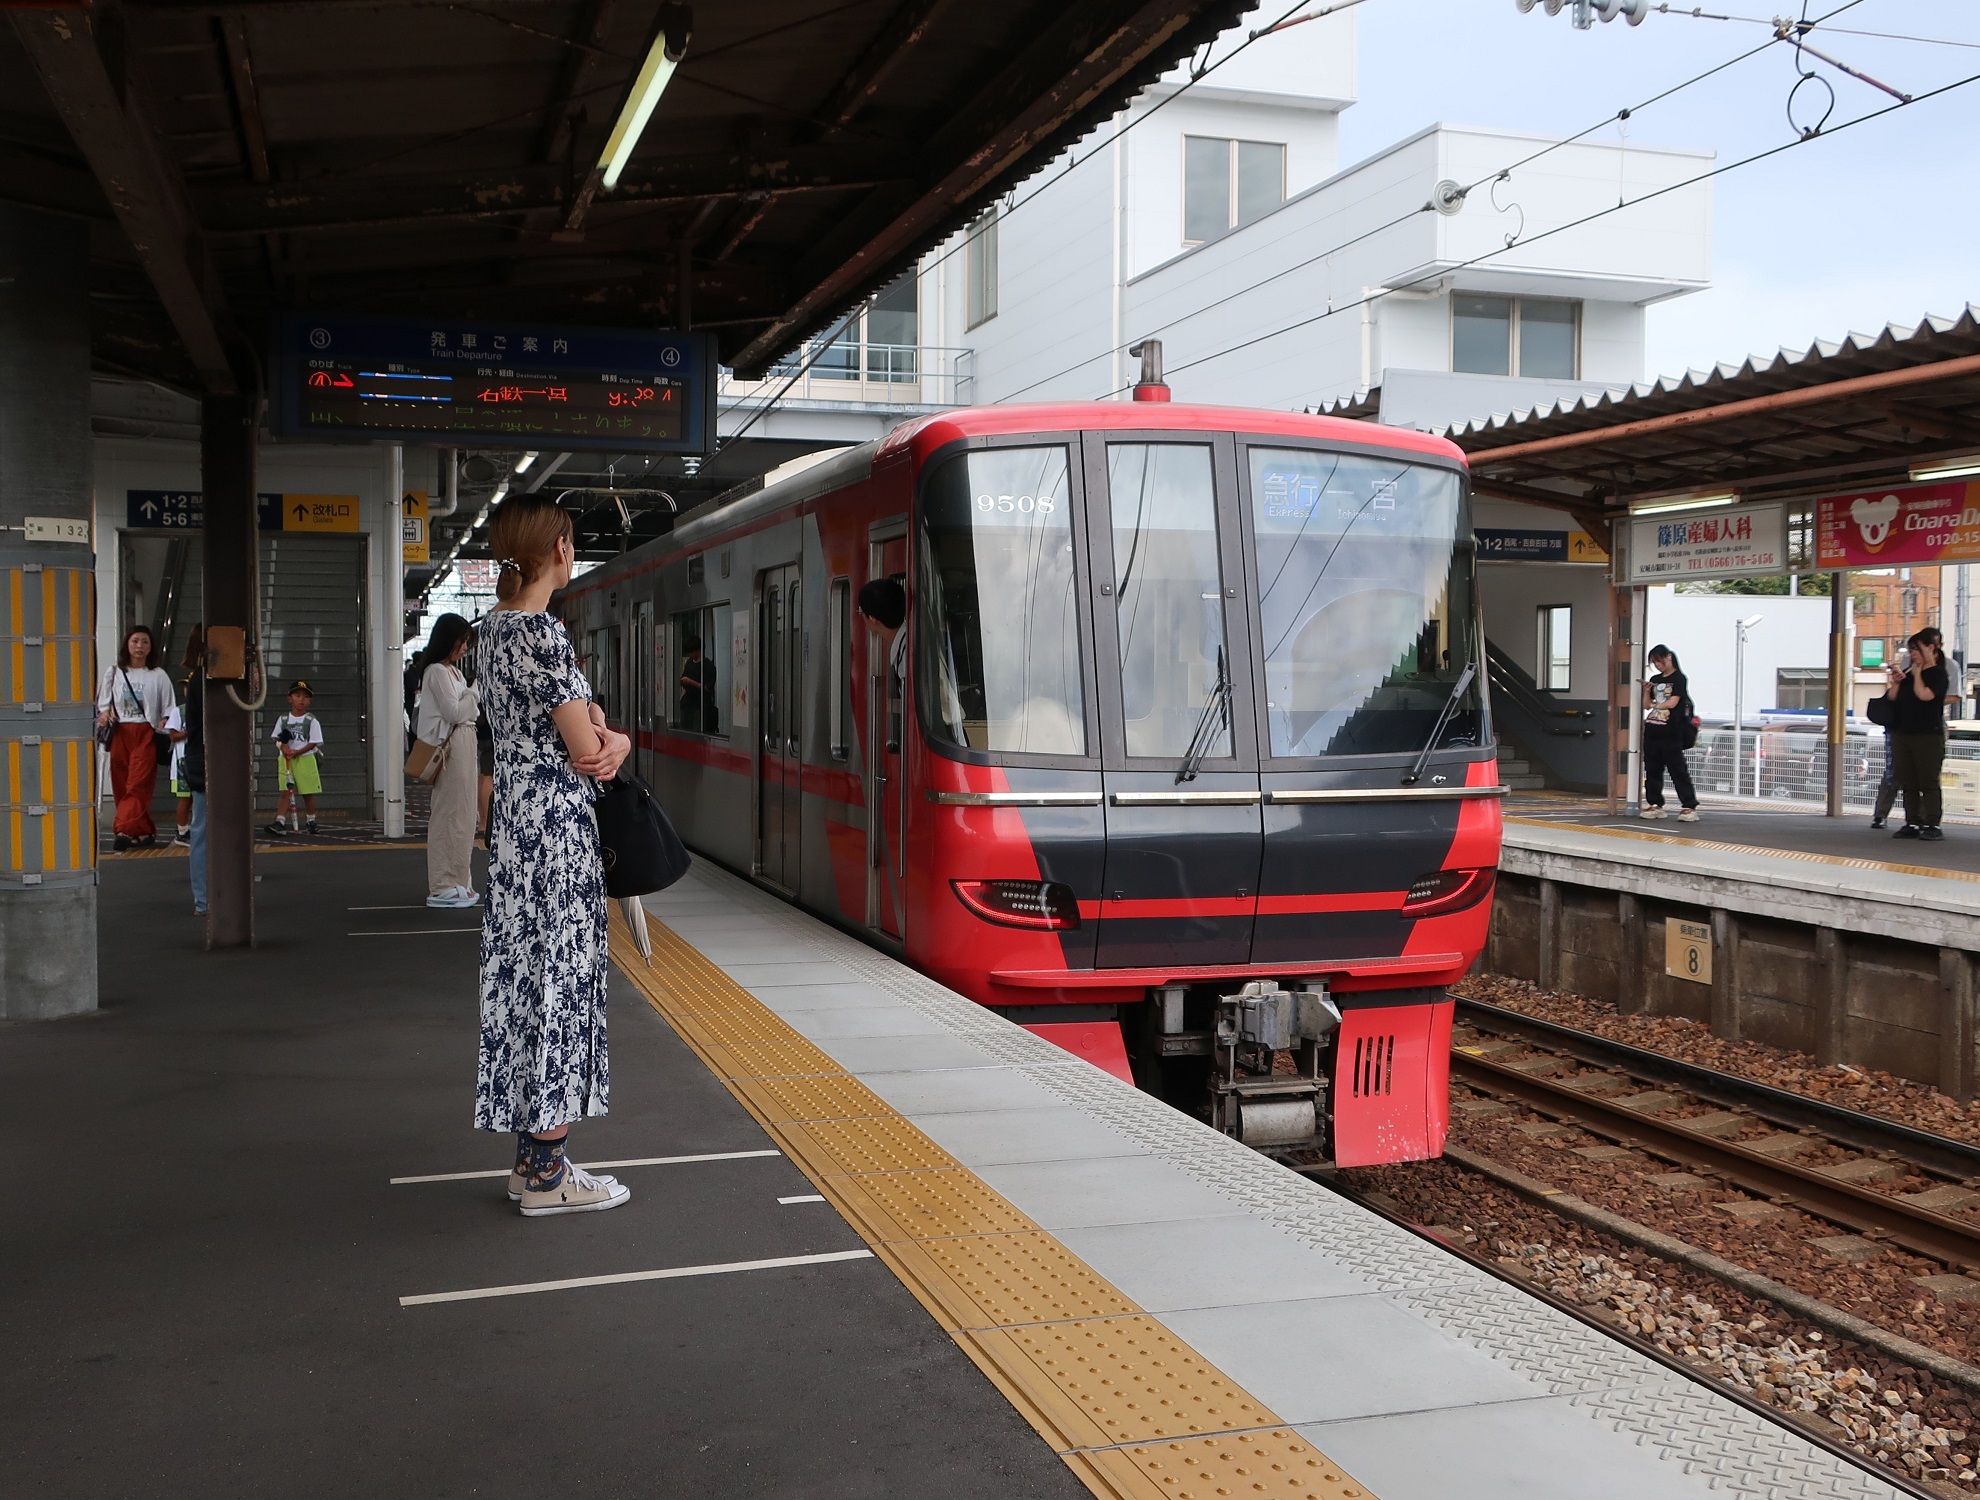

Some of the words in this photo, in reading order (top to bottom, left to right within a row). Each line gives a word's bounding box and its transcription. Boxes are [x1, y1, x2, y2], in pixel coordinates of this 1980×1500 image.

[431, 331, 568, 354] 発車ご案内
[431, 349, 455, 358] Train
[457, 350, 502, 361] Departure
[309, 360, 334, 368] のりば
[388, 364, 404, 372] 種別
[601, 374, 617, 383] 時刻
[1264, 473, 1318, 507] 急行
[313, 504, 350, 517] 改札口
[977, 494, 1055, 514] 9508
[1269, 506, 1311, 518] Express
[1337, 509, 1387, 521] Ichinomiya
[1688, 559, 1703, 569] TEL
[1689, 948, 1698, 973] 8
